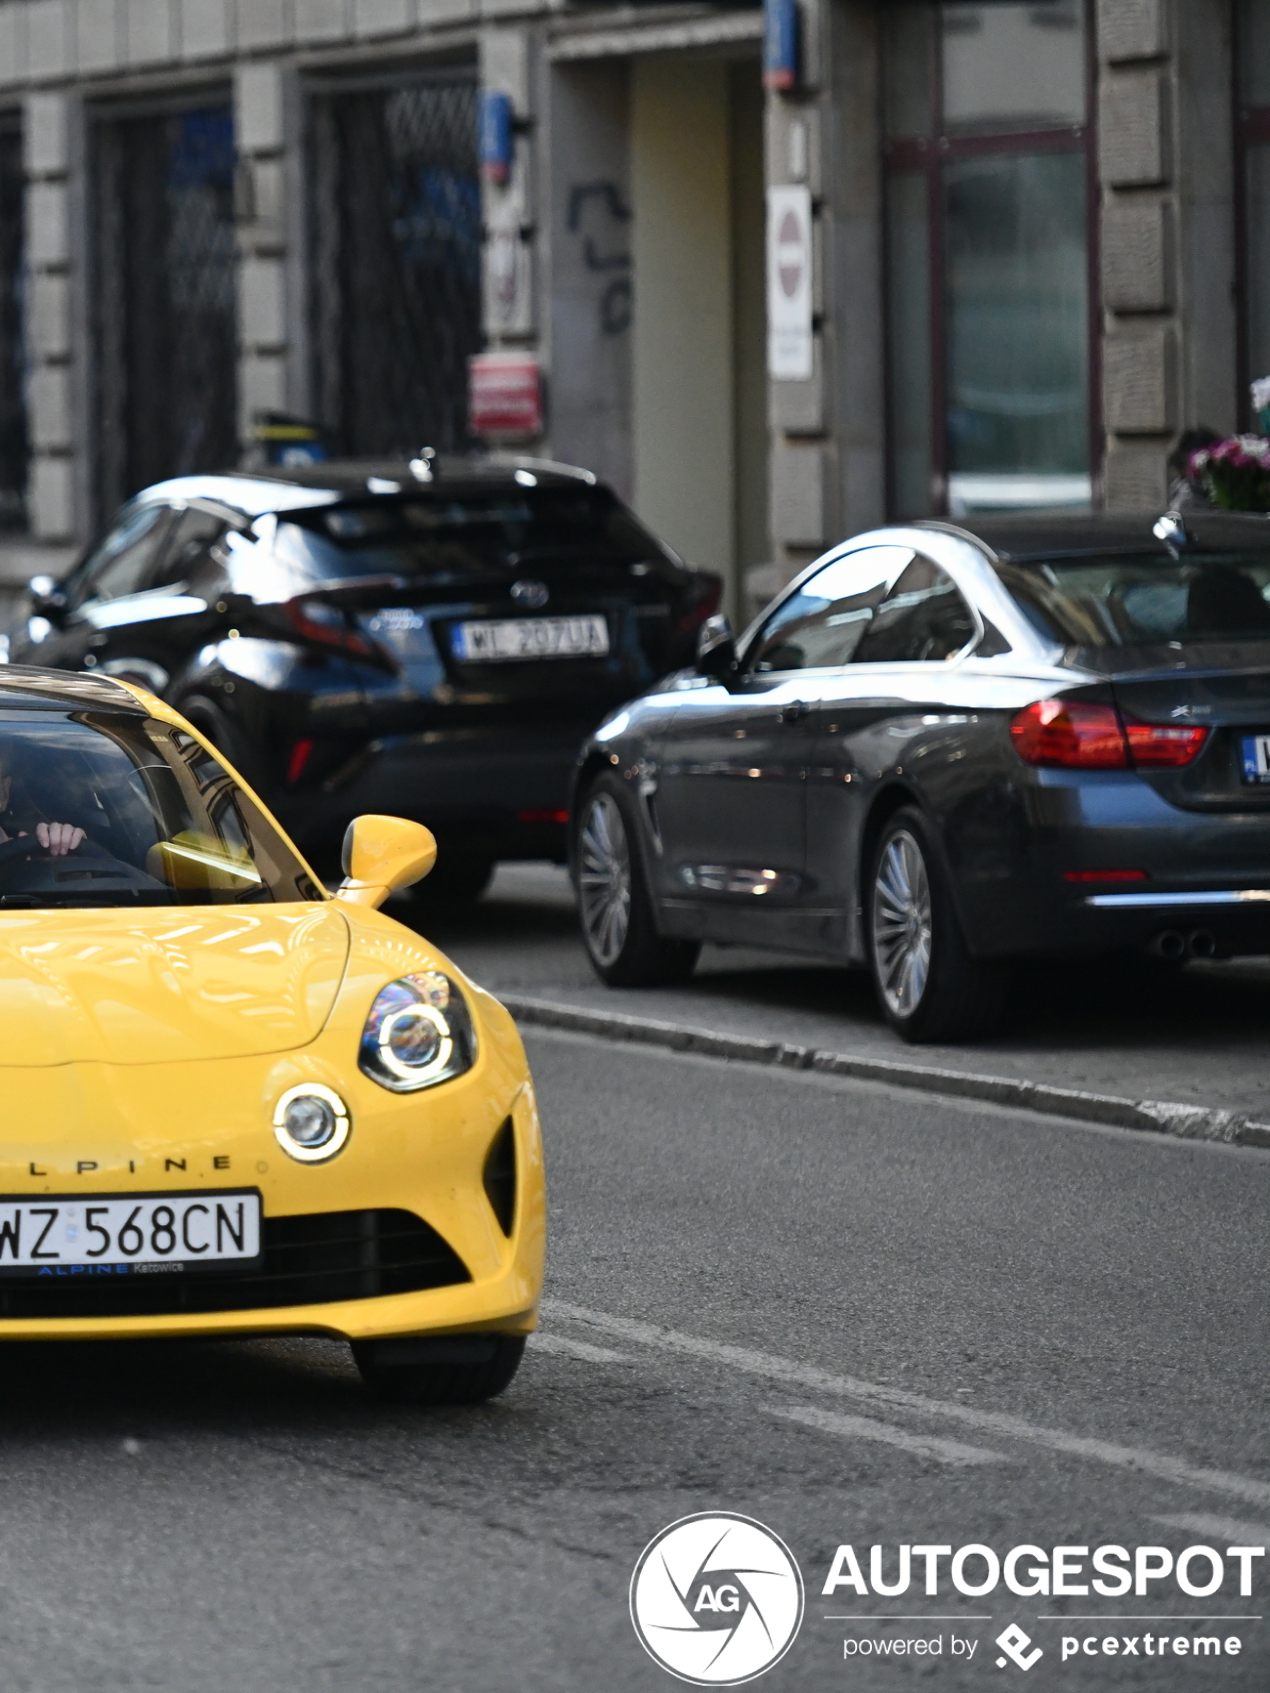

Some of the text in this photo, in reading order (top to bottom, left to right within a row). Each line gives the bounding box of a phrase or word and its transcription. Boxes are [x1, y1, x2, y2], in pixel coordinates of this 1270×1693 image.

[85, 1202, 245, 1258] 568CN
[38, 1261, 185, 1276] ALPINE Katowice
